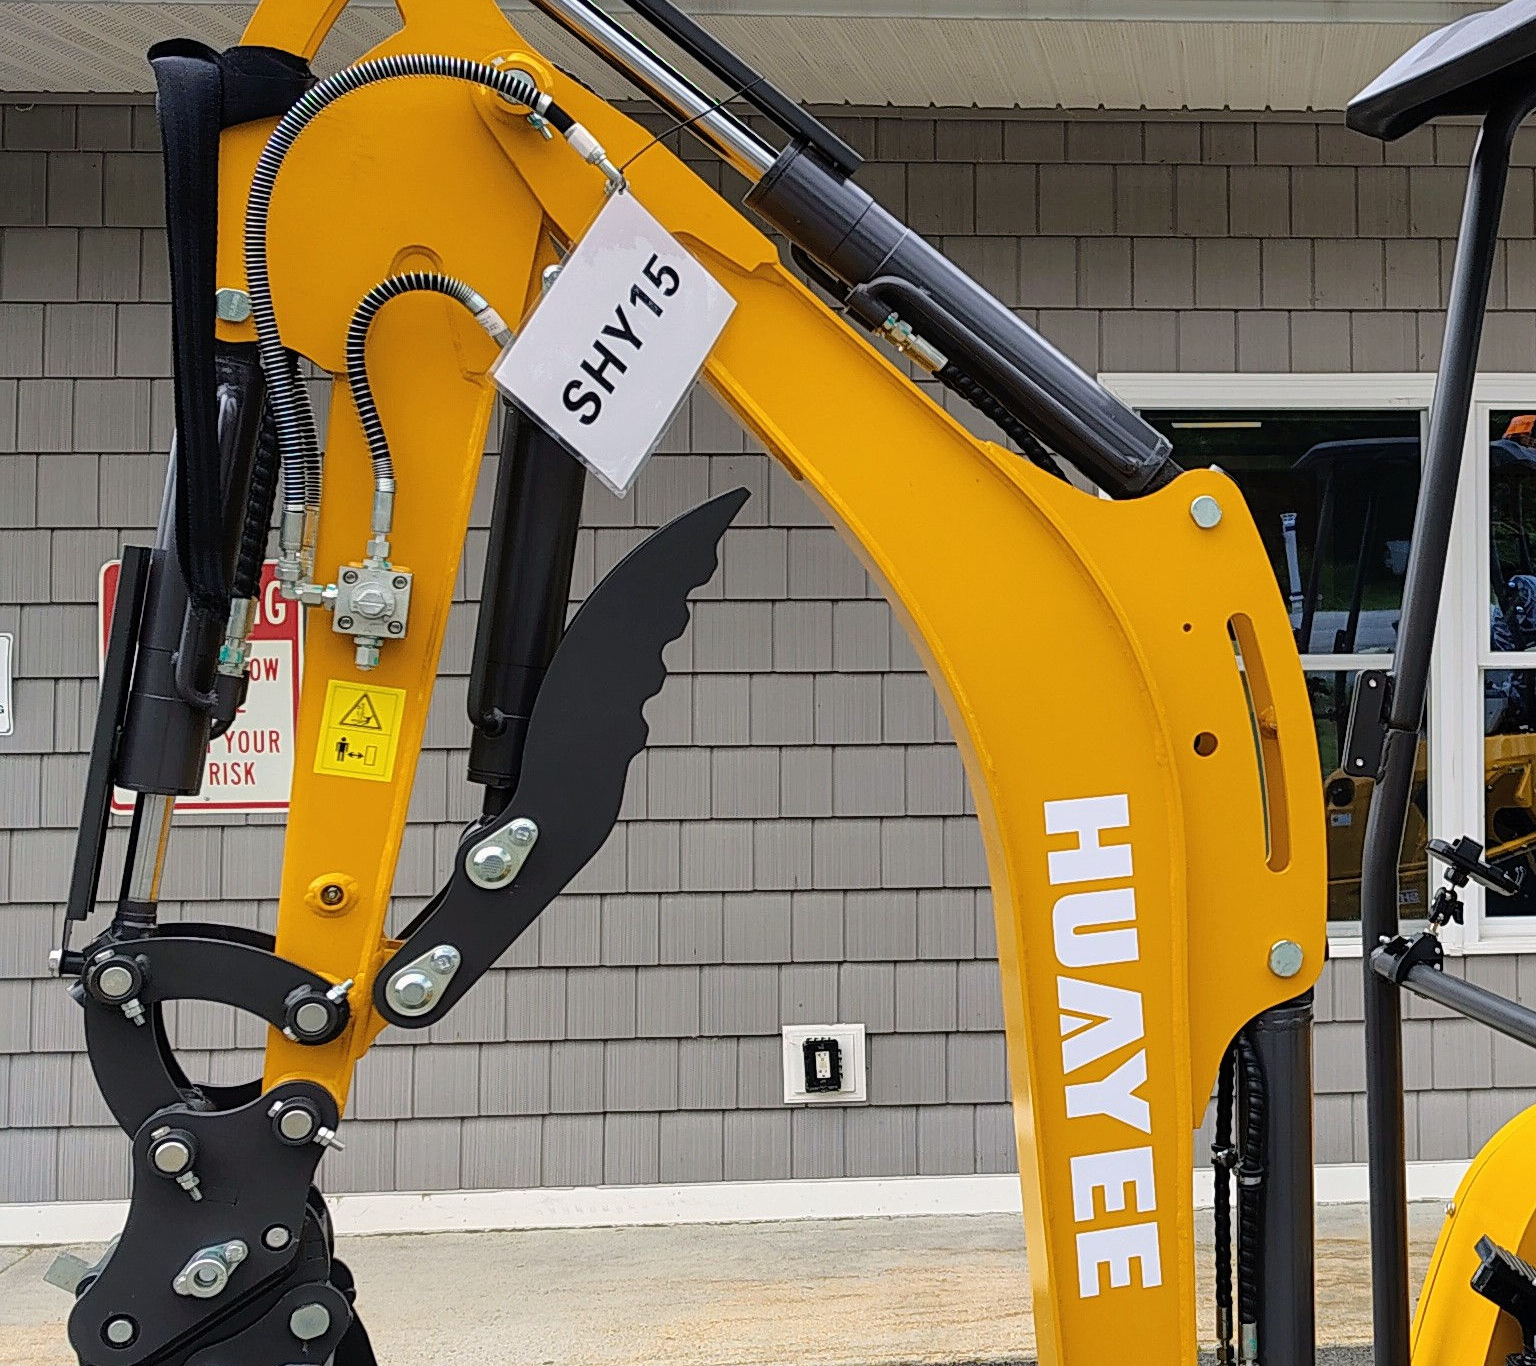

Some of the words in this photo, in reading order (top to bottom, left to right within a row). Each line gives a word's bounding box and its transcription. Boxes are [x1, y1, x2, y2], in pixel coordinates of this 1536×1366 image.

[562, 253, 681, 426] SHY15
[249, 658, 279, 681] OW
[224, 730, 281, 753] YOUR
[209, 762, 256, 786] RISK
[1043, 794, 1162, 1299] HUAYEE
